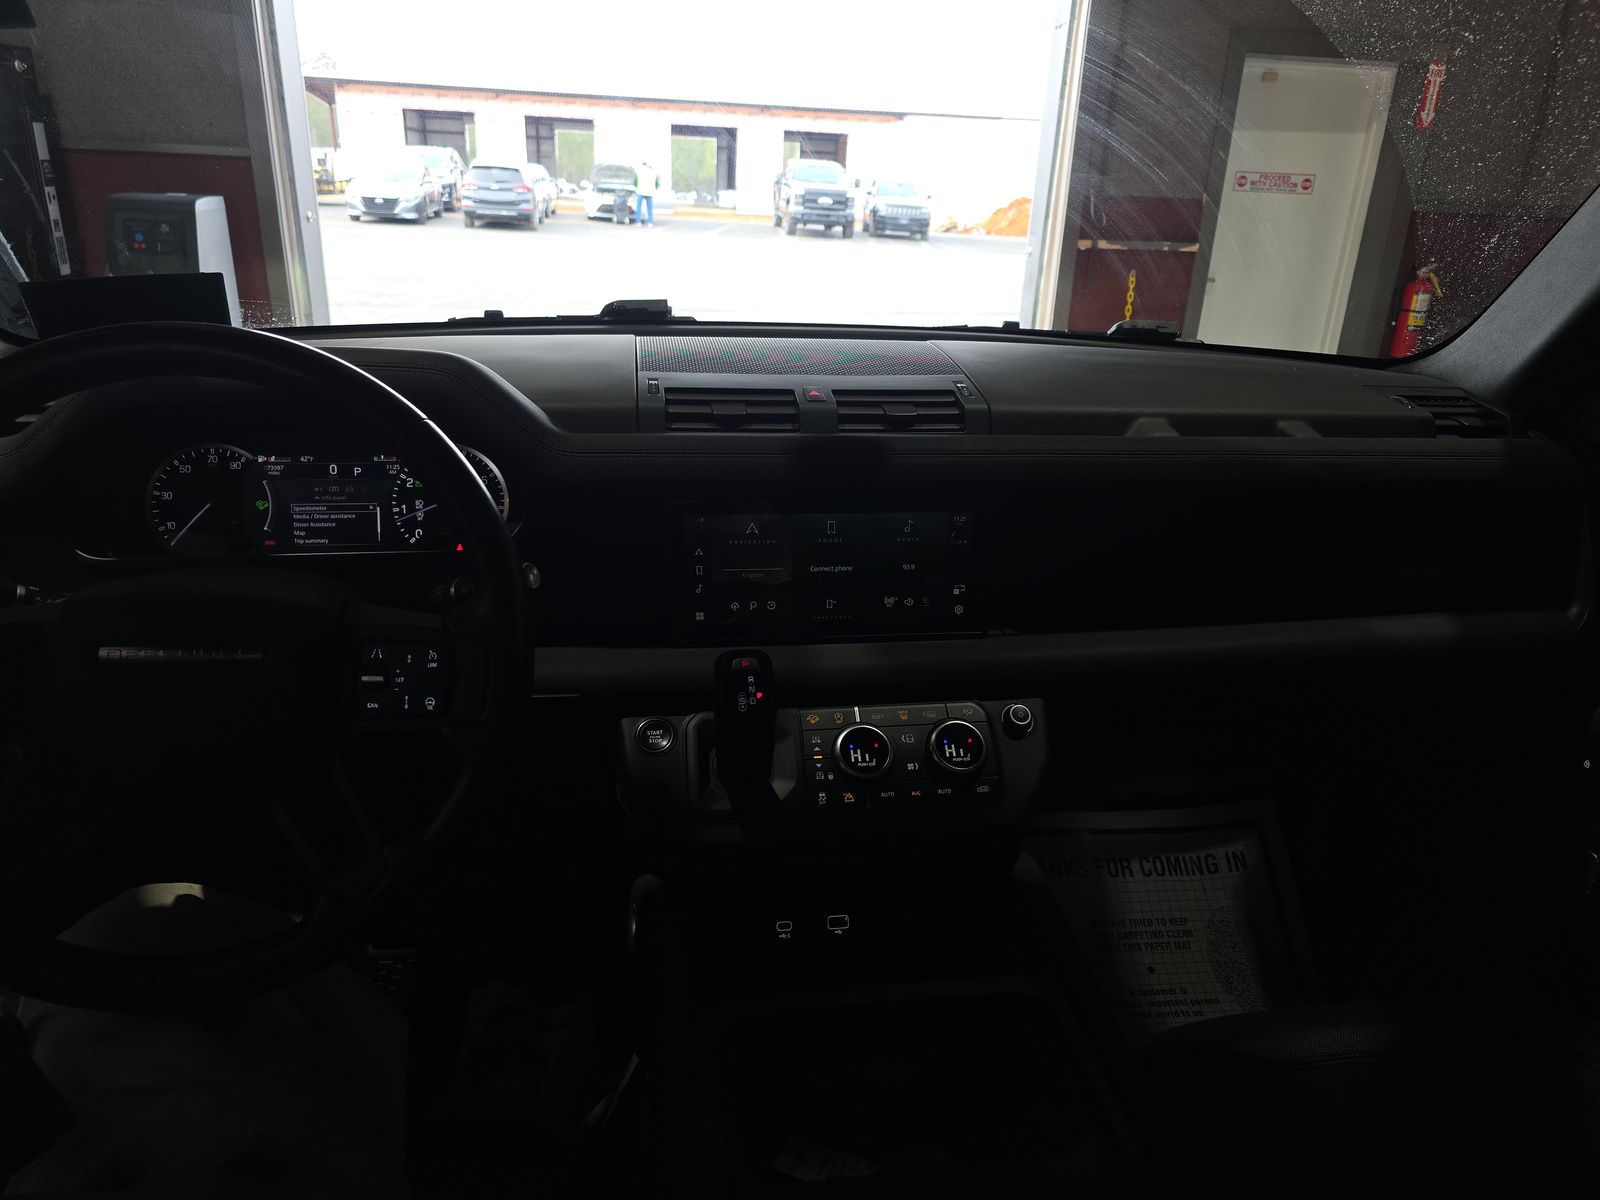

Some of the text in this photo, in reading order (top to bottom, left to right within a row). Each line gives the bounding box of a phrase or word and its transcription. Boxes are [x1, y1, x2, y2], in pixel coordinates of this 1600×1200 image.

[1259, 174, 1292, 182] PROCEED
[1268, 180, 1298, 189] CAUTION
[207, 455, 219, 464] 70
[179, 465, 192, 474] 50
[229, 461, 242, 470] 90
[329, 464, 362, 477] 0 P
[406, 478, 414, 488] 2
[160, 491, 173, 501] 30
[401, 504, 406, 514] 1
[166, 521, 176, 530] 10
[810, 564, 854, 574] Connect phone
[742, 659, 750, 668] P
[748, 676, 755, 684] R
[748, 685, 756, 694] N
[749, 697, 757, 705] D
[1095, 856, 1135, 879] FOR
[1139, 853, 1221, 879] COMING
[1225, 850, 1249, 873] IN
[1128, 918, 1154, 928] TRIED
[1154, 918, 1167, 927] TO
[1168, 917, 1189, 927] KEEP
[1118, 930, 1165, 941] CARPETING
[1166, 928, 1194, 939] CLEAN
[1123, 942, 1144, 953] THIS
[1144, 941, 1172, 952] PAPER
[1173, 940, 1193, 951] MAT
[1137, 987, 1177, 997] customer
[1144, 998, 1189, 1009] important
[1189, 997, 1221, 1009] person
[1154, 1010, 1181, 1019] world
